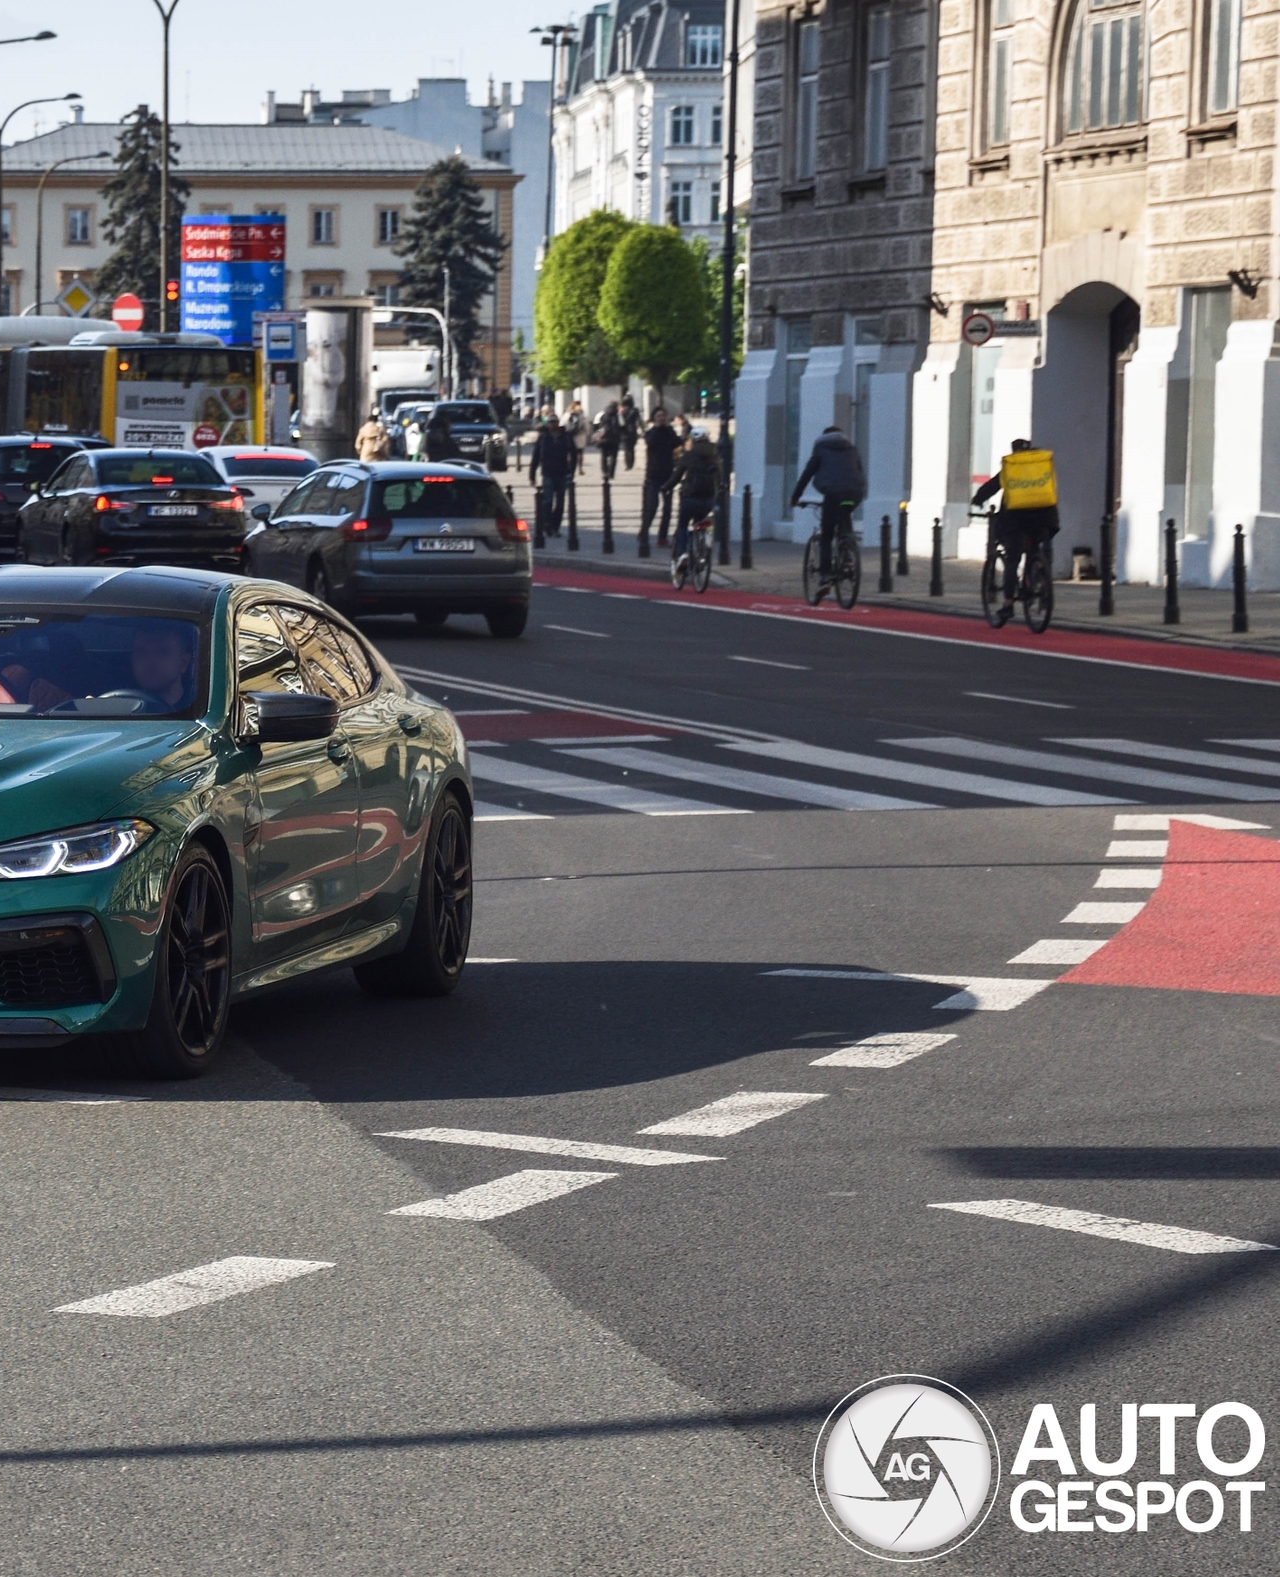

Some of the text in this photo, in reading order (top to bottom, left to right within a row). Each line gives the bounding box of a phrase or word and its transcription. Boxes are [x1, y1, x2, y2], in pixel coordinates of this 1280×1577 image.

[637, 104, 651, 167] INDIGO
[185, 226, 246, 240] Śródmieście
[186, 245, 243, 261] Saska Kępa
[185, 265, 218, 277] Rondo
[197, 281, 265, 296] Dmowskiego
[185, 302, 229, 314] Muzeum
[185, 317, 237, 330] Narodowe
[142, 396, 185, 406] pomelo
